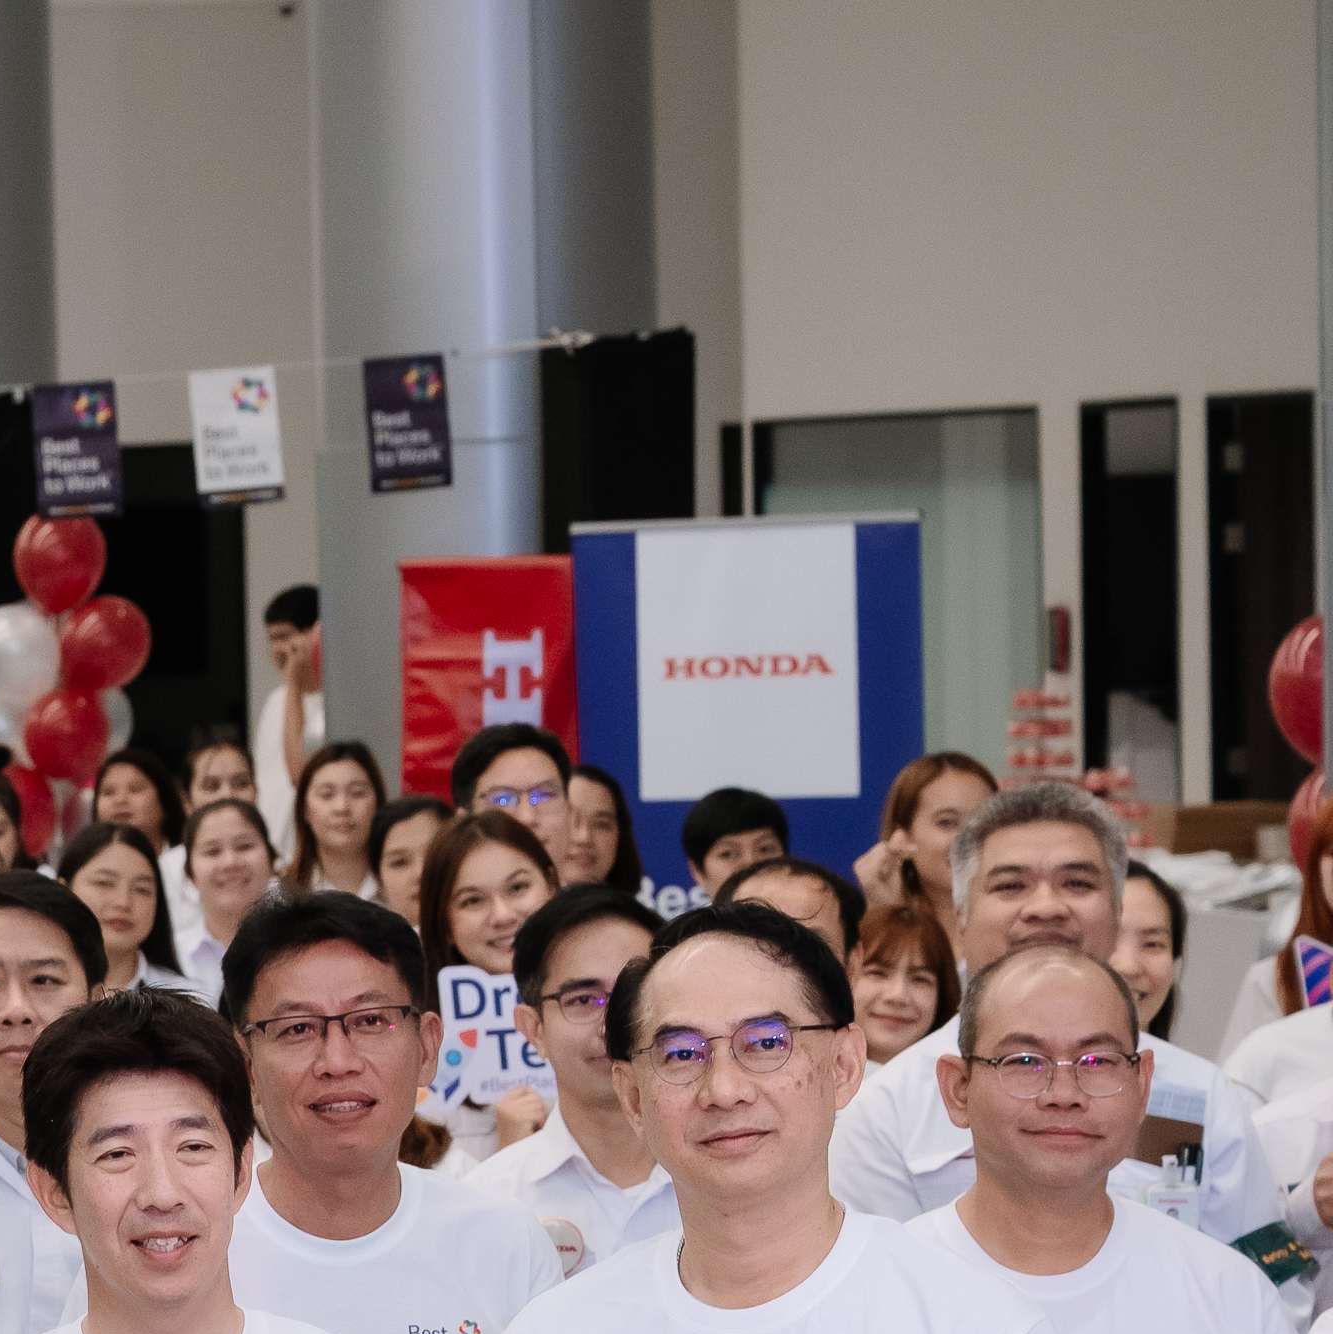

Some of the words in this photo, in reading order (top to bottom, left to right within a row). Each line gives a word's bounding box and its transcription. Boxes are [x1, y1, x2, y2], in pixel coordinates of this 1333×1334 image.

[371, 410, 410, 429] Best
[41, 437, 80, 455] Best
[373, 429, 431, 446] Places
[43, 455, 101, 473] Places
[375, 451, 396, 468] to
[44, 477, 64, 495] to
[664, 653, 833, 680] HONDA
